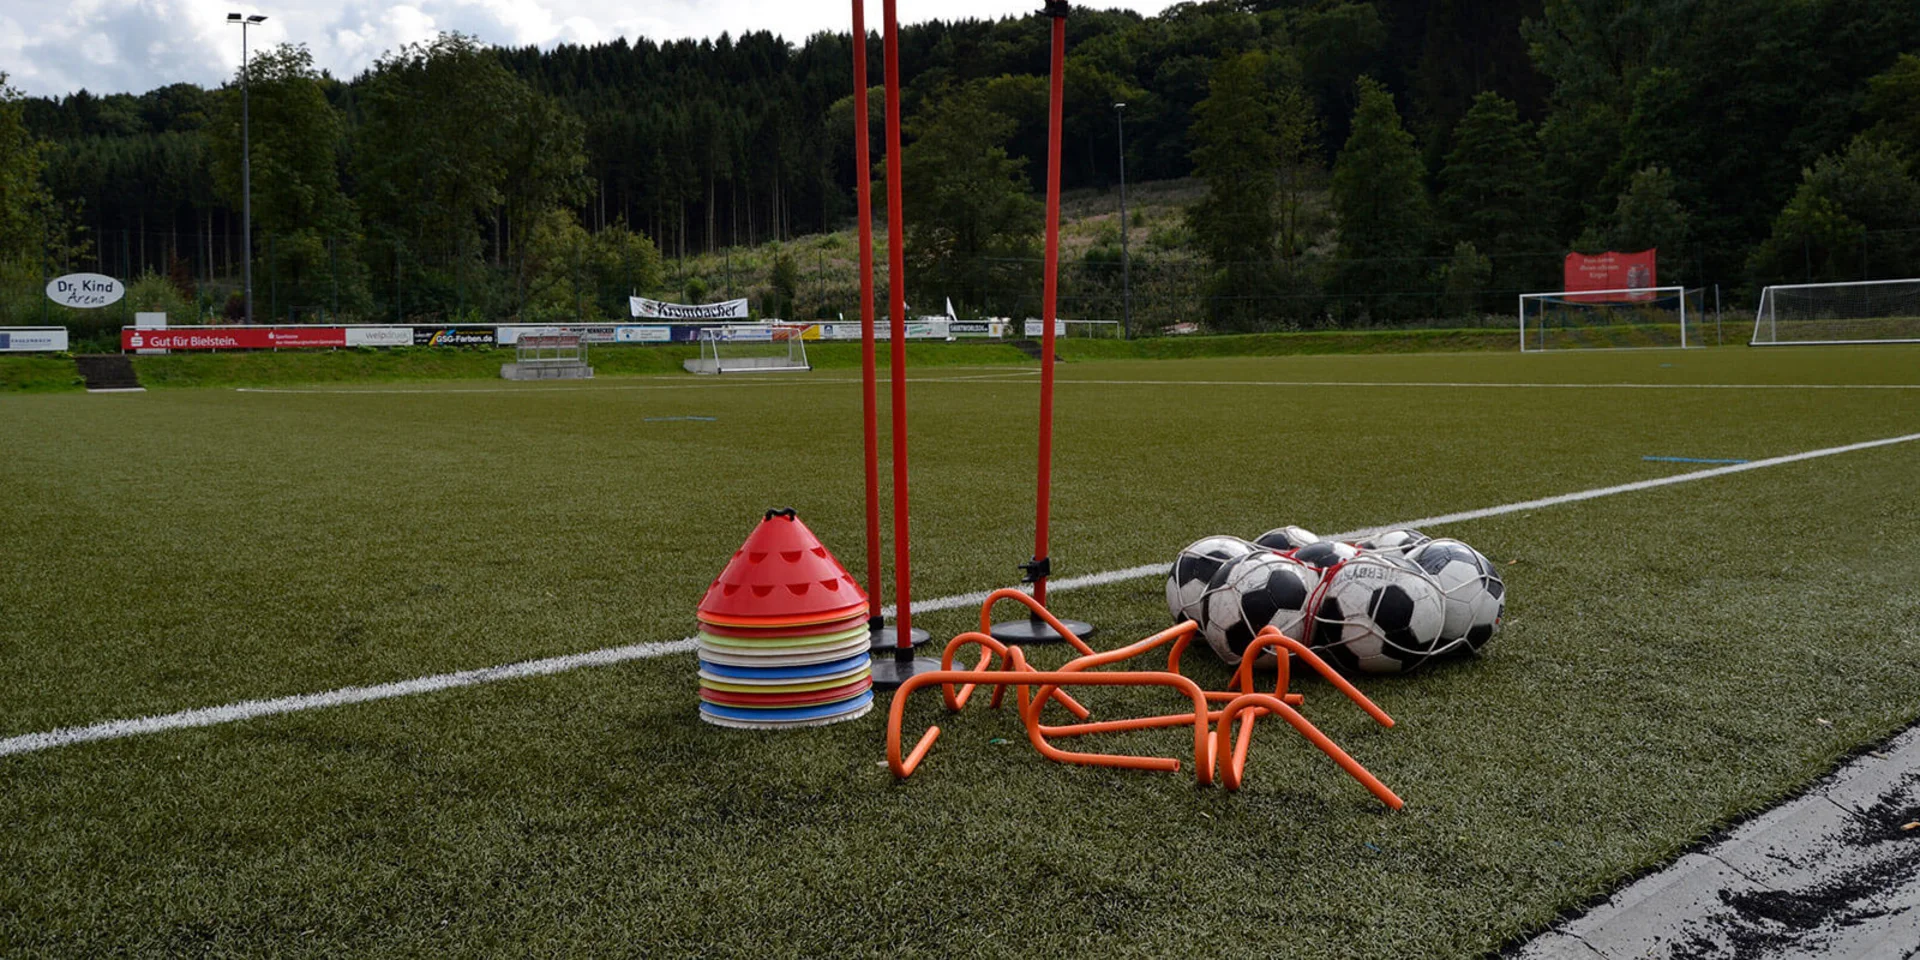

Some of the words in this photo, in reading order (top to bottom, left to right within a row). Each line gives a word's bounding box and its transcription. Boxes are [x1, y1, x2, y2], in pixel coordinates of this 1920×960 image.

[82, 279, 114, 293] Kind
[67, 289, 106, 304] Arena
[657, 302, 738, 318] Krombacher
[150, 336, 171, 347] Gut
[173, 335, 189, 347] für
[190, 335, 239, 347] Bielstein.
[436, 335, 493, 343] GSG-Farben.de
